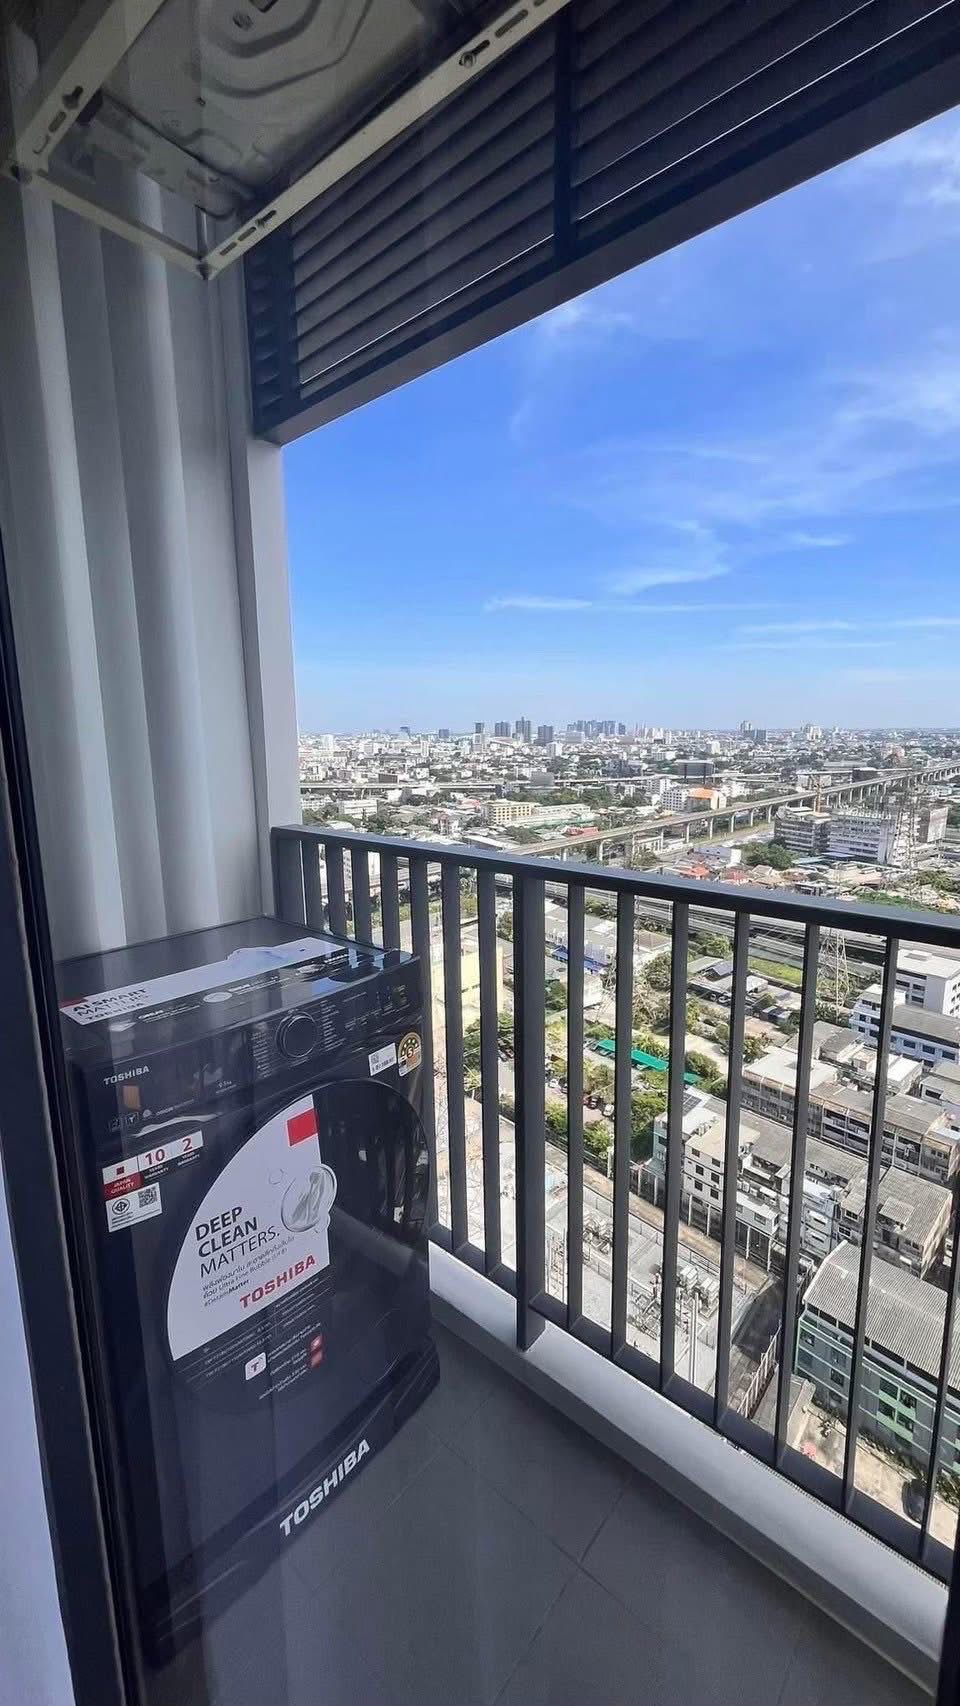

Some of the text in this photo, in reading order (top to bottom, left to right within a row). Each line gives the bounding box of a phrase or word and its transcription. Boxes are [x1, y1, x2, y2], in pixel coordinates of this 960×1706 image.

[103, 1065, 150, 1086] TOSHIBA
[145, 1149, 165, 1166] 10
[182, 1137, 193, 1152] 2
[195, 1206, 243, 1241] DEEP
[198, 1216, 258, 1258] CLEAN
[200, 1225, 280, 1278] MATTERS.
[239, 1254, 316, 1309] TOSHIBA
[279, 1439, 370, 1537] TOSHIBA
